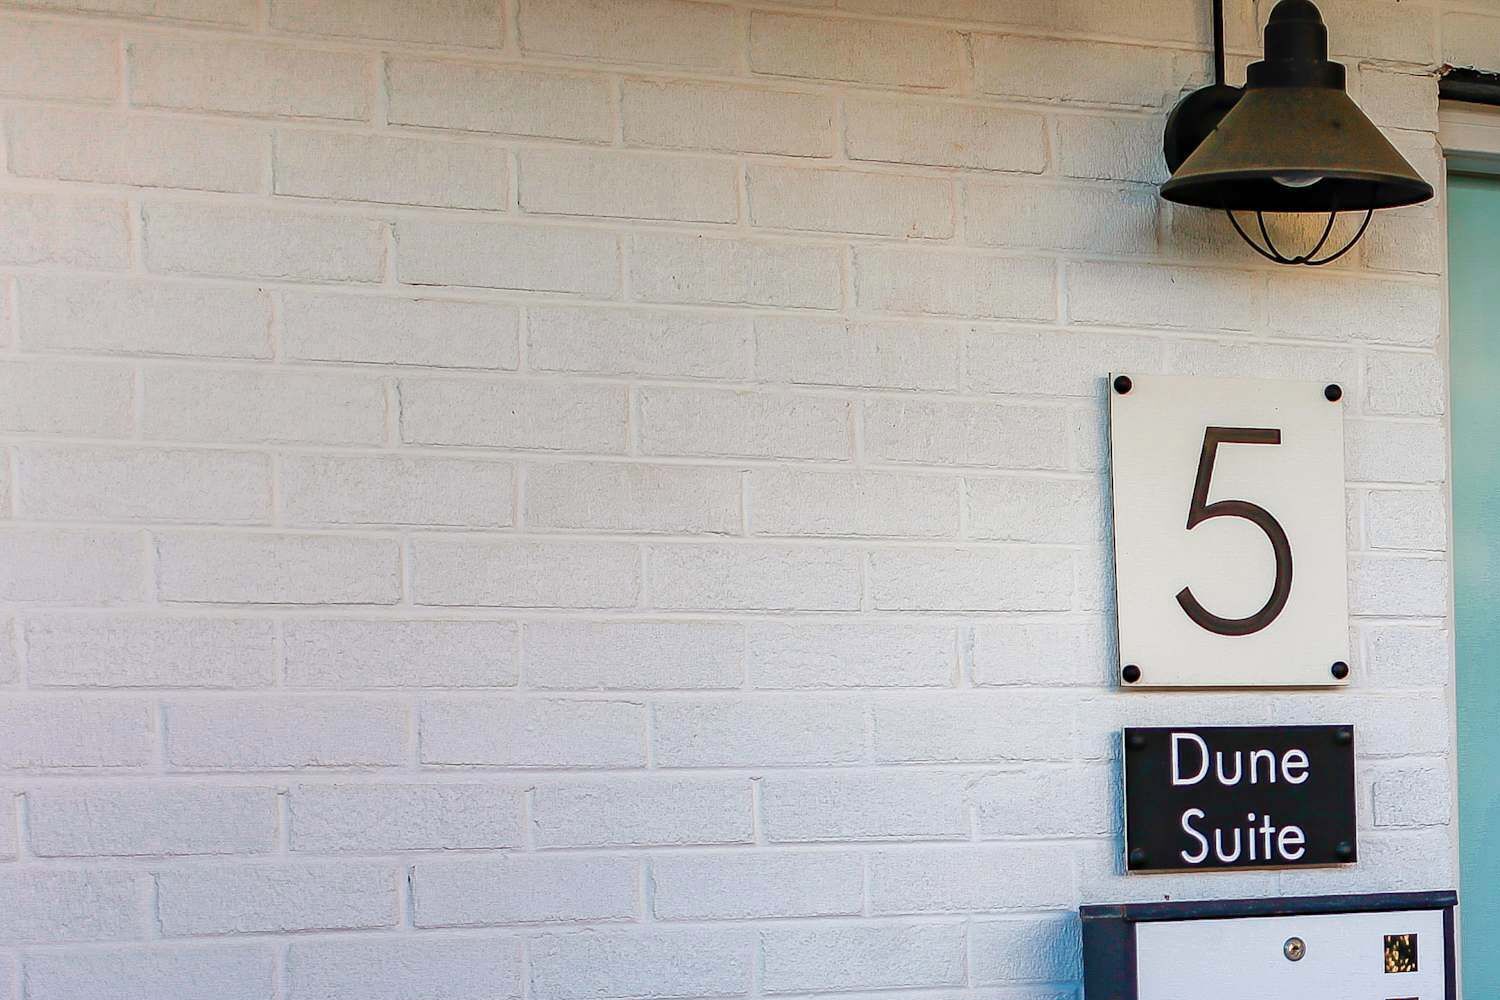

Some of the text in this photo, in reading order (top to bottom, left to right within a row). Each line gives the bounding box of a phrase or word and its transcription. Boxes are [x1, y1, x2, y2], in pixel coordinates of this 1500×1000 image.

[1175, 426, 1293, 636] 5
[1171, 732, 1310, 786] Dune
[1181, 808, 1305, 864] Suite
